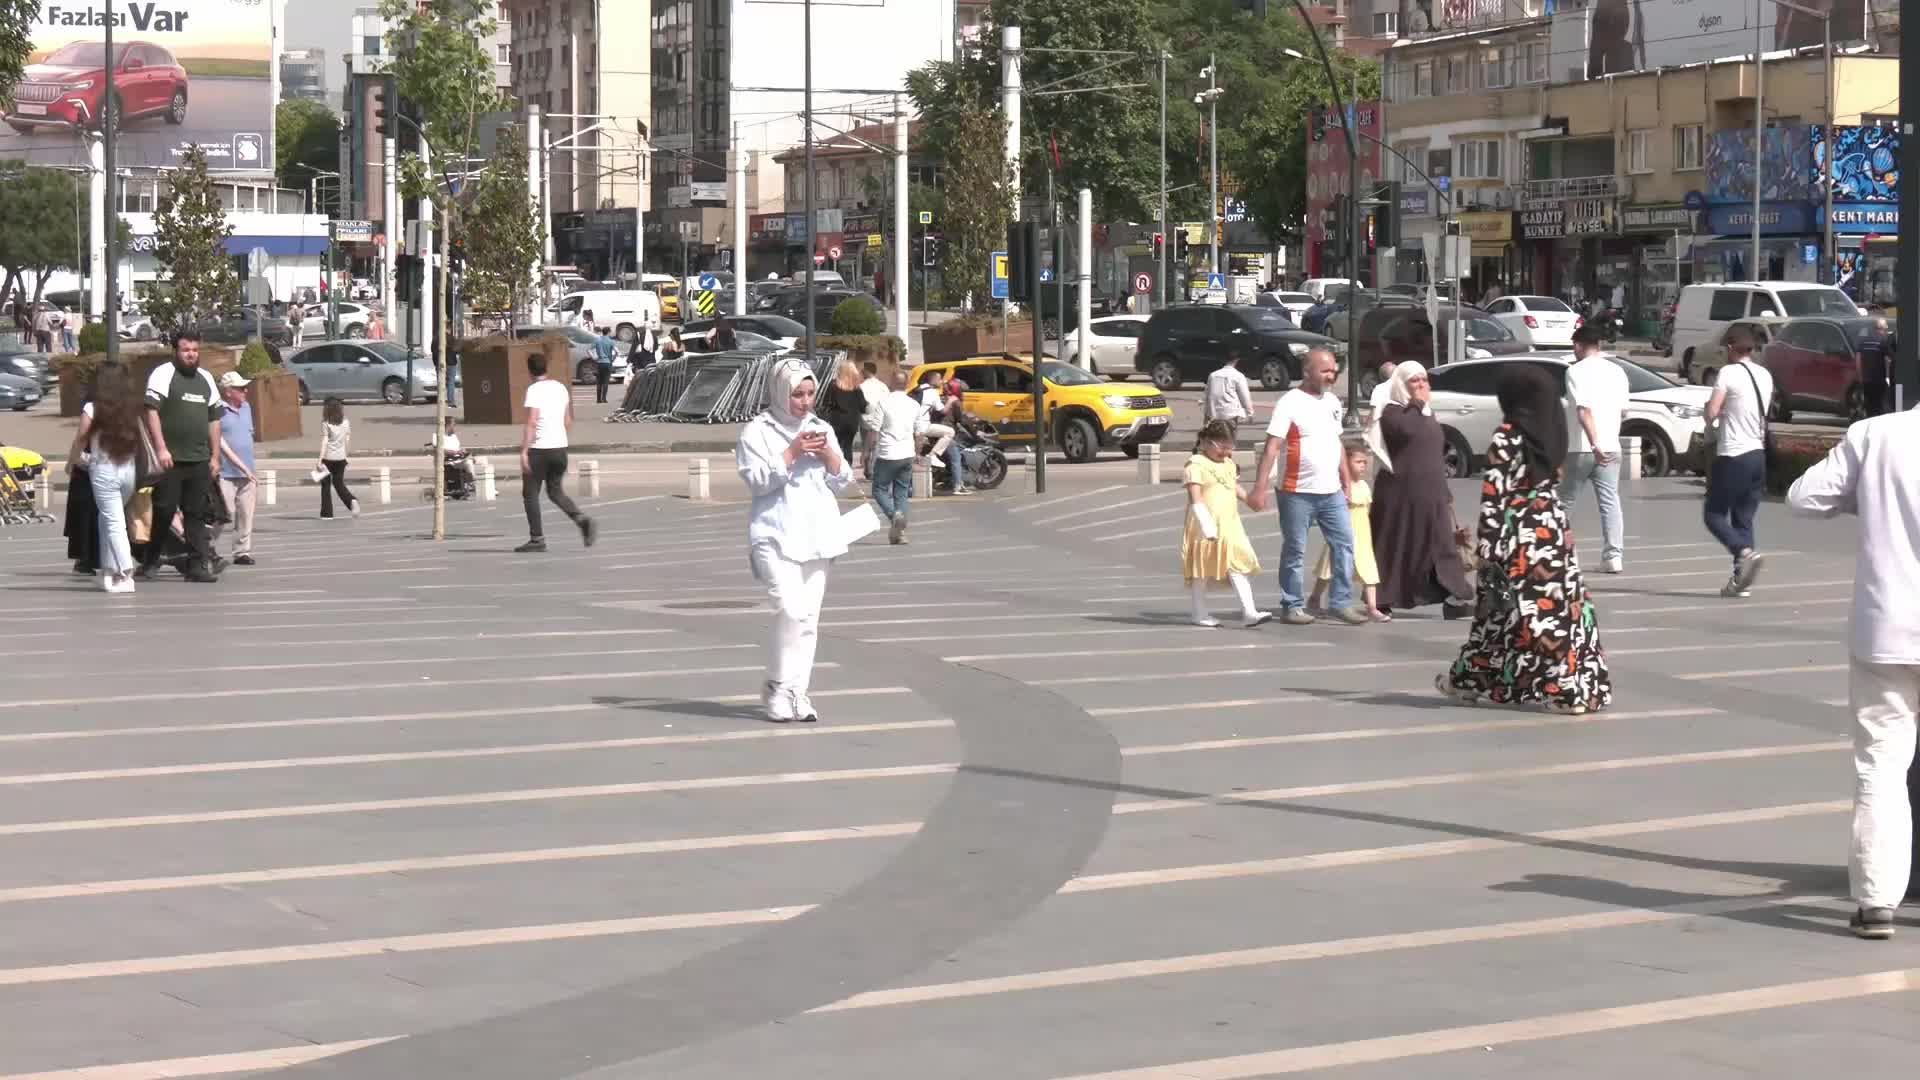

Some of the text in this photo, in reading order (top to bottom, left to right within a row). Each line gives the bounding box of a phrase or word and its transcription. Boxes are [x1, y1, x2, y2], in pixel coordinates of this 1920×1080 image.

[48, 2, 189, 31] Fazlası Var
[1699, 14, 1722, 32] dyson
[1832, 210, 1863, 222] KENT
